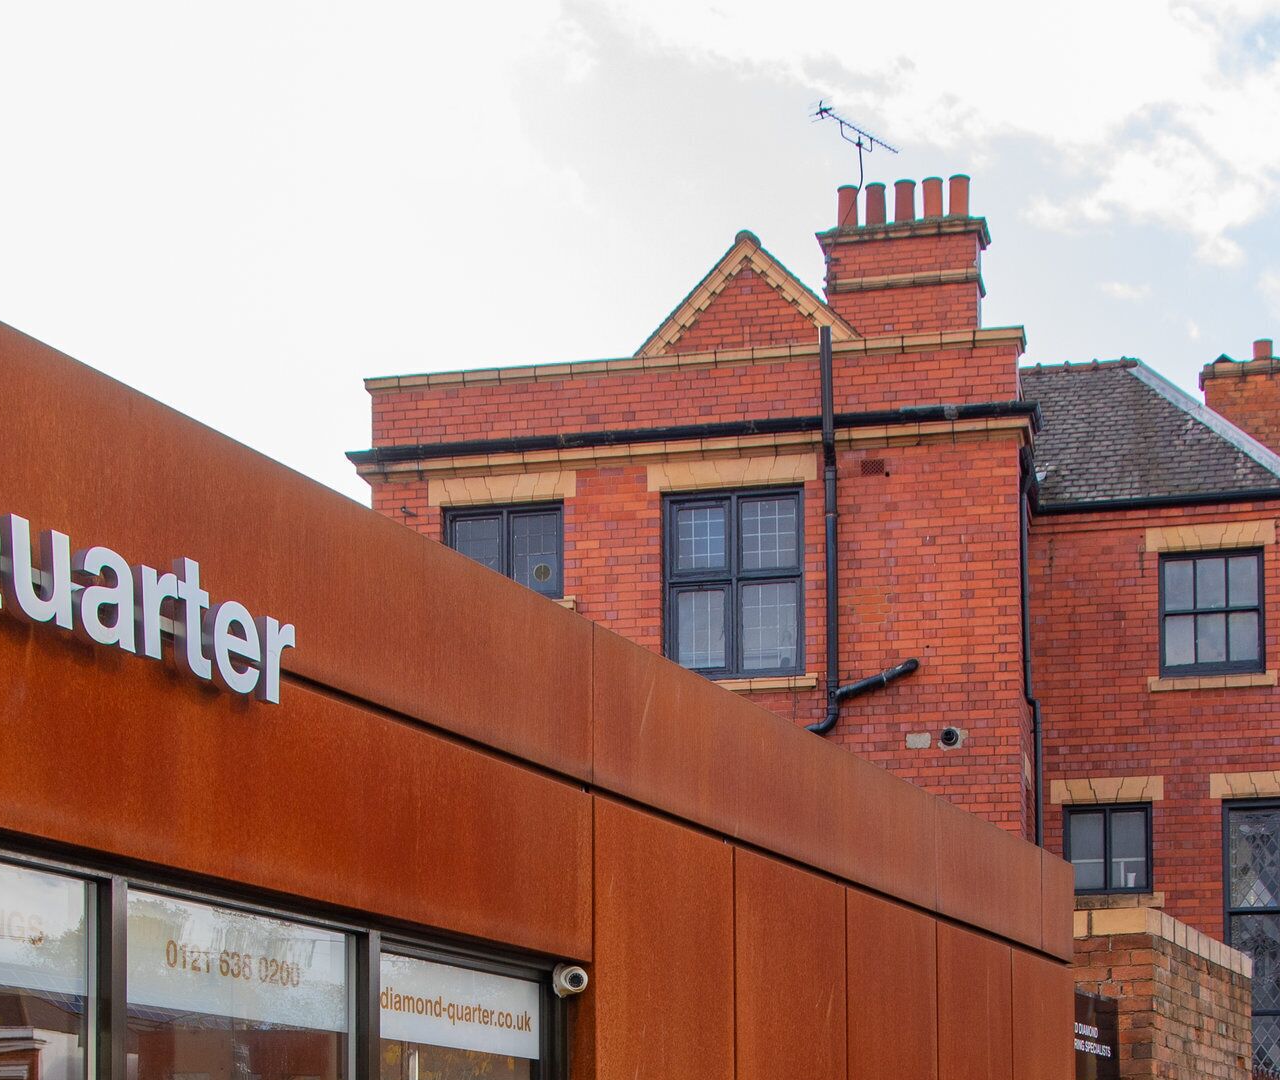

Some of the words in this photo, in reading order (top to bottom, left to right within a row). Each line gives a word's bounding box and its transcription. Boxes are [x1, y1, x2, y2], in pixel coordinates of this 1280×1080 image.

[165, 939, 211, 974] 0121
[380, 986, 532, 1033] diamond-quarter.co.uk
[1079, 1023, 1098, 1038] DIAMOND
[1085, 1041, 1111, 1057] SPECIALISTS
